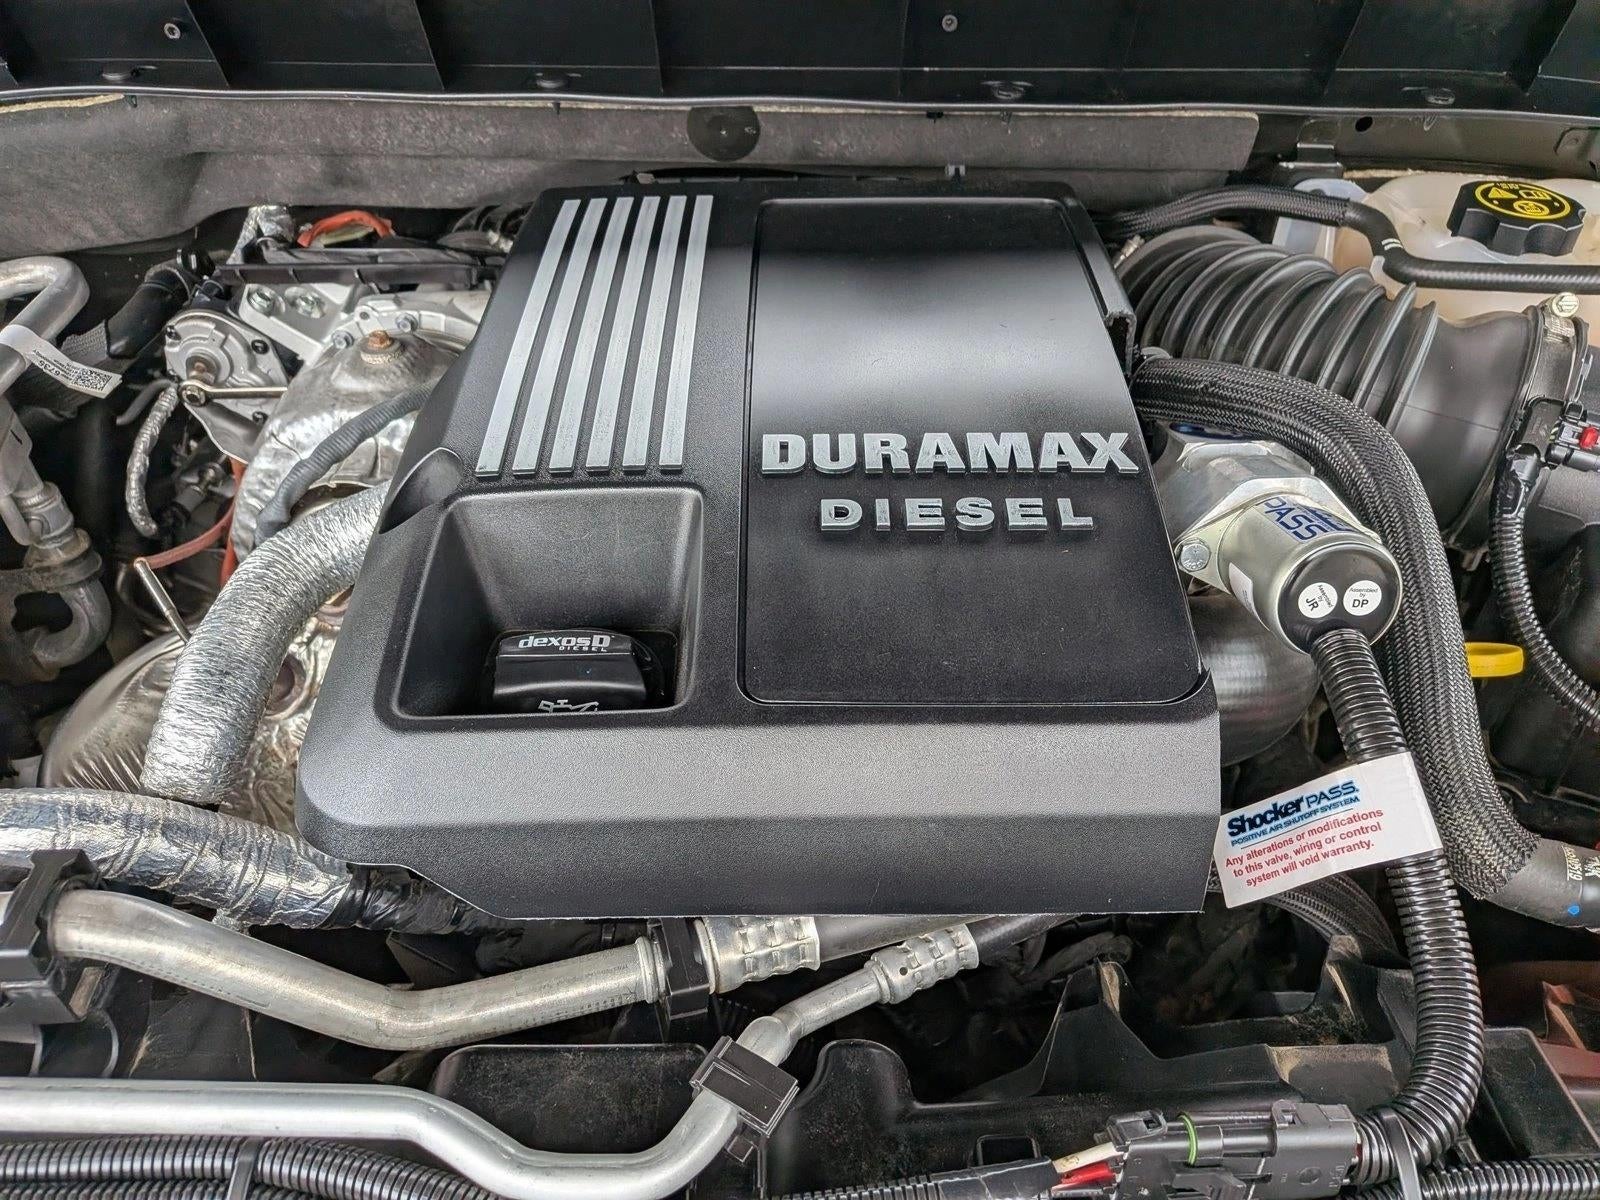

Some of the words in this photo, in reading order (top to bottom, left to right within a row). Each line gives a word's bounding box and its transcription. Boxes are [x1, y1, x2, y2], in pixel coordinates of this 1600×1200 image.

[39, 360, 61, 376] 6735
[761, 432, 1139, 474] DURAMAX
[820, 497, 1093, 531] DIESEL
[1258, 497, 1328, 541] PASS
[1306, 598, 1319, 611] JR
[1352, 599, 1368, 608] DP
[1226, 855, 1244, 868] Any
[1246, 837, 1294, 860] alterations
[1296, 832, 1306, 841] or
[1308, 808, 1383, 836] modifications
[1231, 831, 1269, 846] POSITIVE
[1269, 824, 1283, 835] AIR
[1283, 809, 1319, 828] SHUTOFF
[1319, 797, 1360, 813] SYSTEM
[1233, 867, 1243, 878] to
[1245, 861, 1263, 873] this
[1265, 852, 1293, 865] valve,
[1293, 839, 1323, 857] wiring
[1325, 835, 1336, 844] or
[1339, 822, 1382, 840] control
[1246, 870, 1280, 887] system
[1281, 861, 1298, 875] will
[1298, 852, 1320, 867] void
[1322, 840, 1374, 859] warranty.
